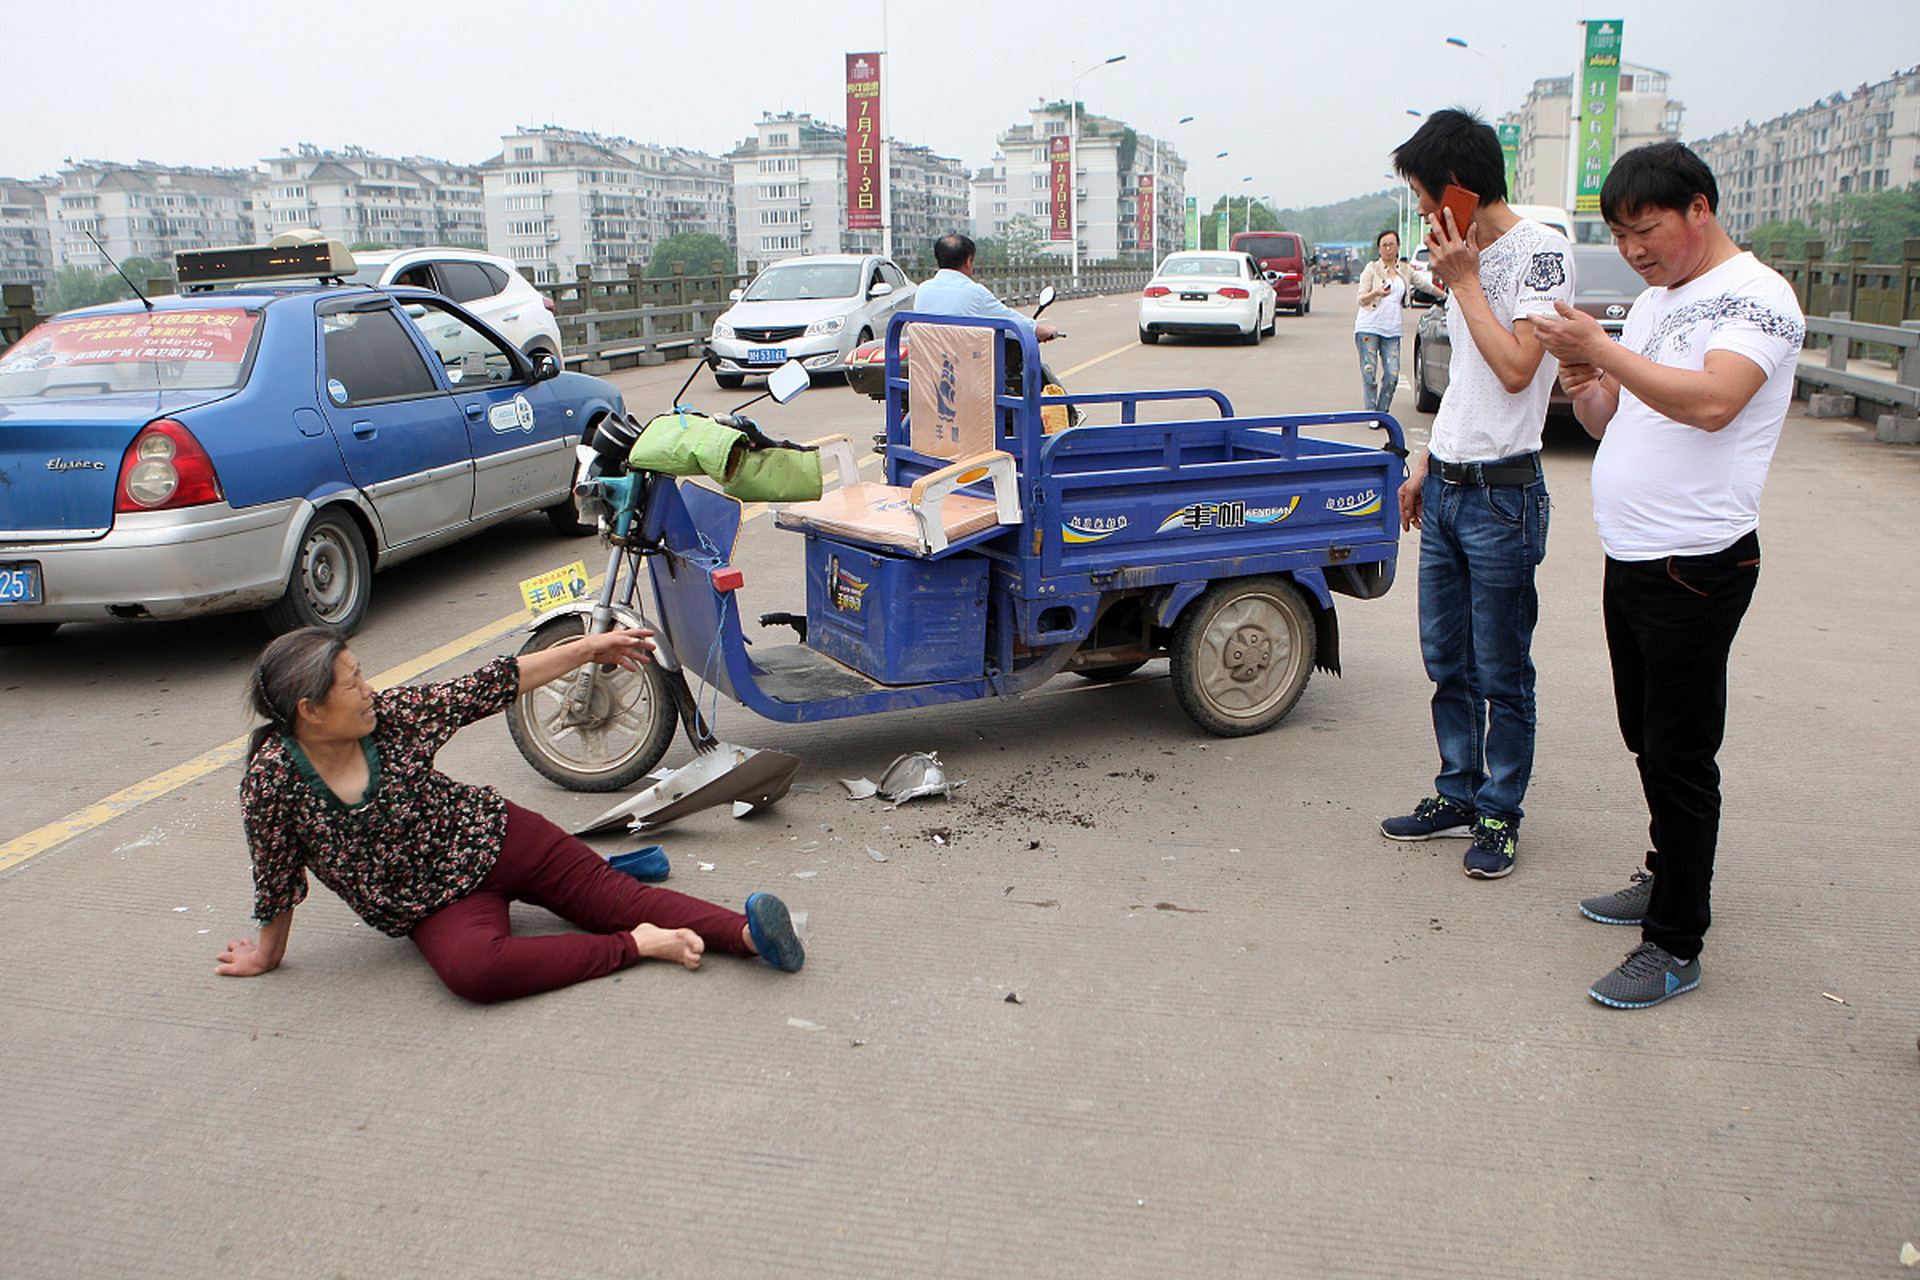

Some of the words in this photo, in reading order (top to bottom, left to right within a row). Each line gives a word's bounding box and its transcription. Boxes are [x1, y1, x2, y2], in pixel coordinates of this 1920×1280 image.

[1583, 80, 1607, 190] 狂享6大福利
[1182, 500, 1246, 530] 丰帆
